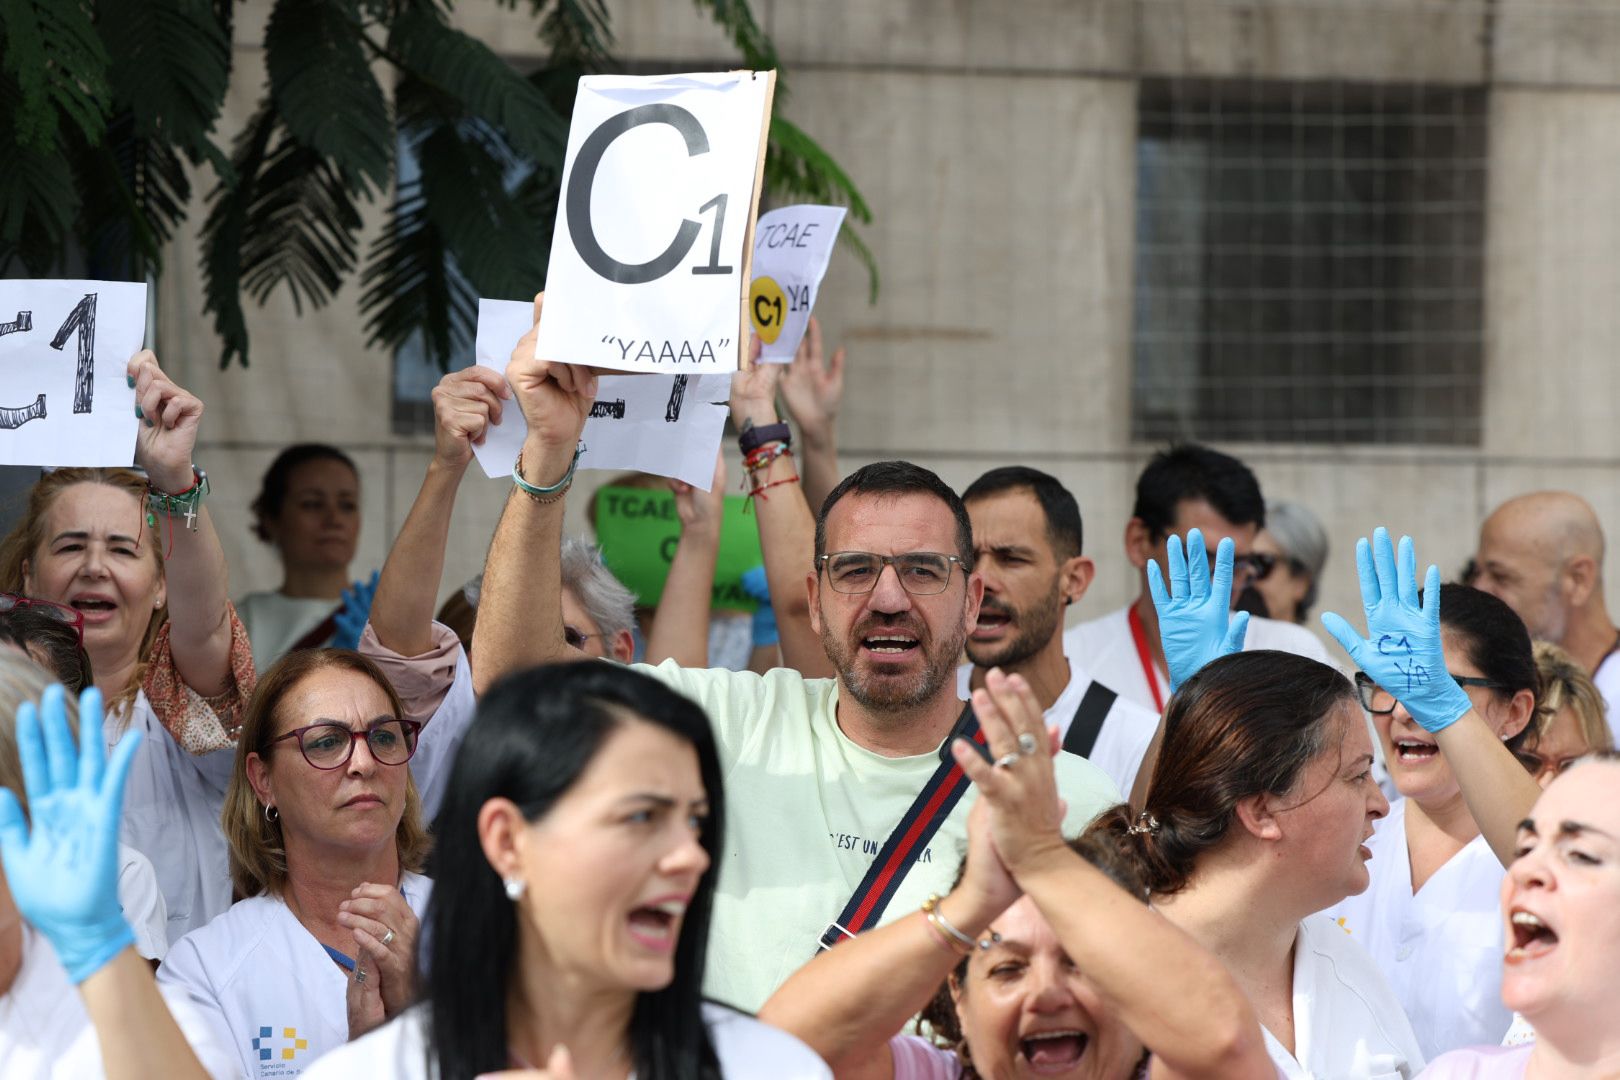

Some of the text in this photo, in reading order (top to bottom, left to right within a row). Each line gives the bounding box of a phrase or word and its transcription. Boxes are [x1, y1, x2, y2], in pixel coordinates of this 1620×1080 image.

[566, 103, 733, 285] C1
[757, 223, 820, 249] TCAE
[754, 285, 810, 327] C1 YA
[830, 833, 860, 850] 'EST
